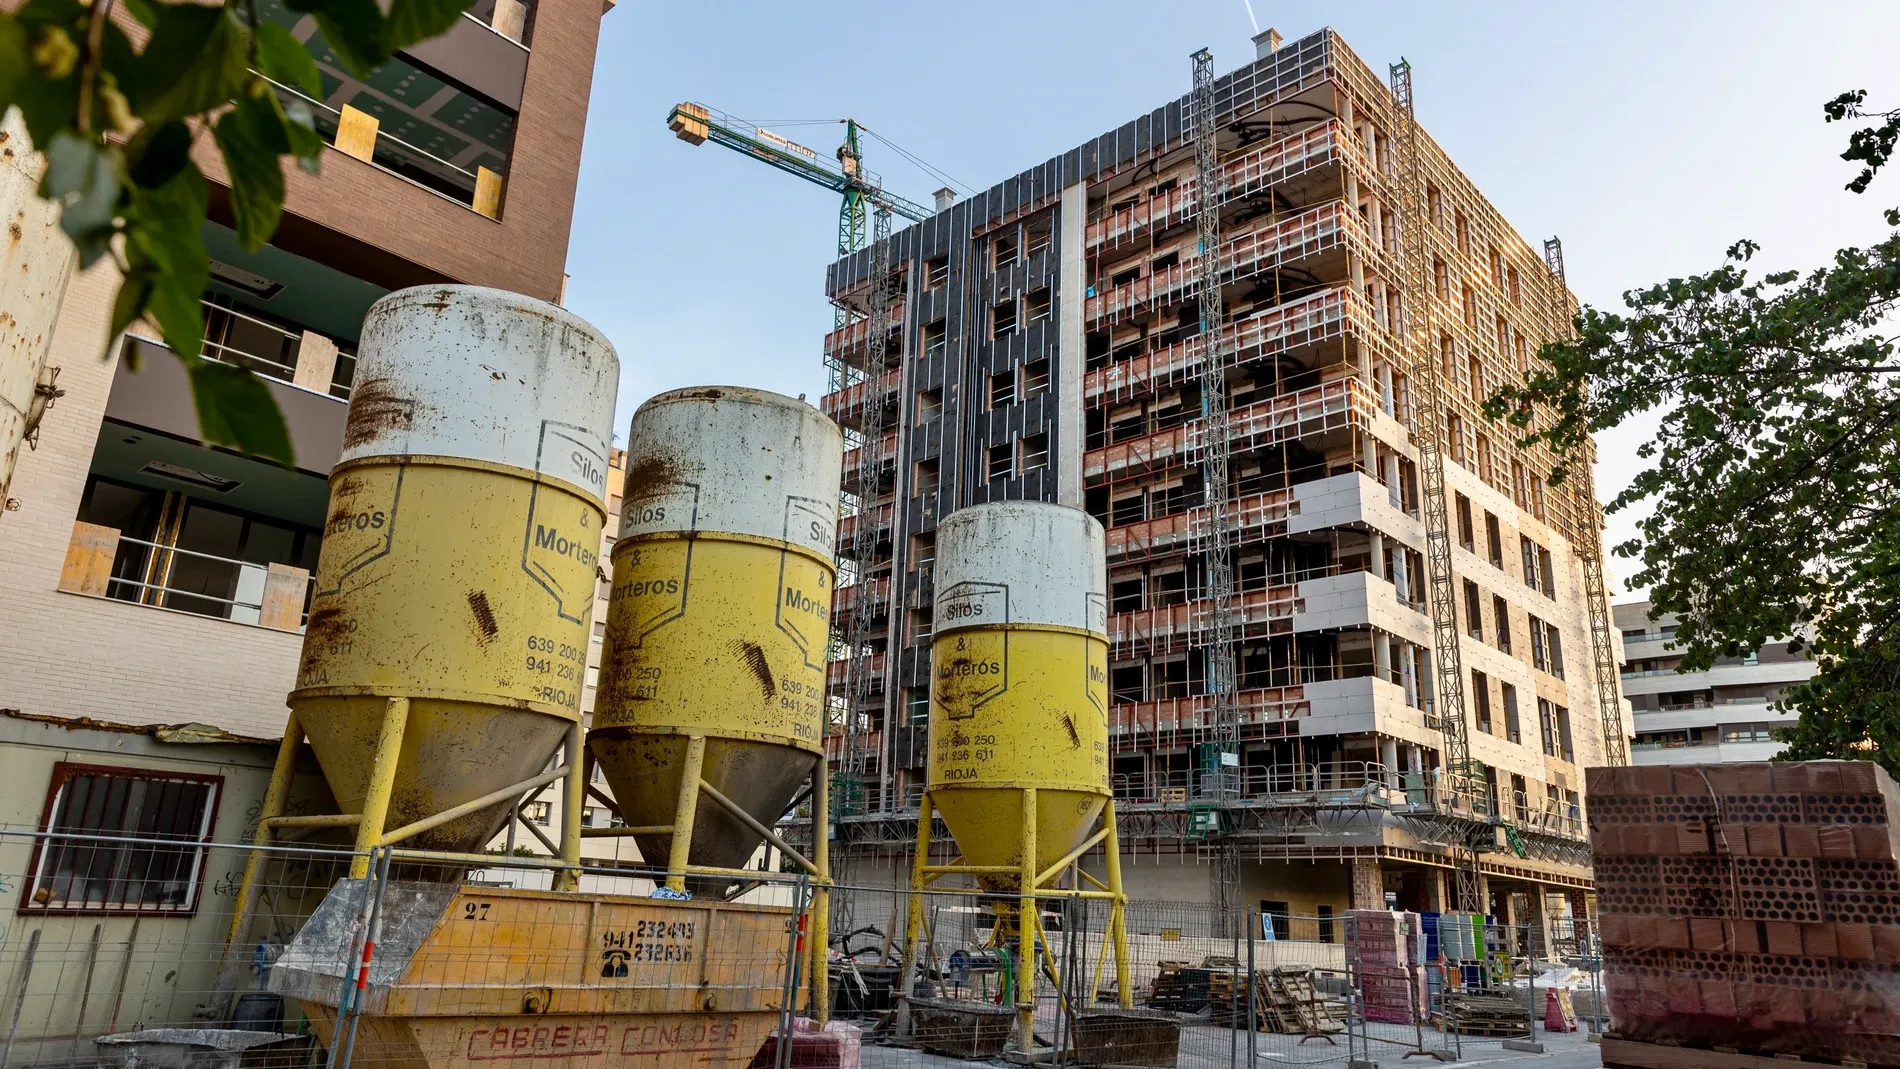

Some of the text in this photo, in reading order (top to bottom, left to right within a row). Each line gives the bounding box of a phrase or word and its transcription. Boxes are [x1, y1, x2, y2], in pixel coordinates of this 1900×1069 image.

[571, 451, 604, 491] Silos
[580, 508, 588, 528] &
[626, 507, 665, 529] Silos
[632, 549, 641, 568] &
[819, 570, 825, 588] &
[946, 602, 983, 620] Silos
[527, 635, 555, 654] 639
[559, 643, 577, 661] 200
[957, 637, 965, 652] &
[525, 656, 551, 674] 941
[557, 663, 575, 682] 236
[637, 667, 661, 680] 250
[636, 684, 658, 699] 611
[782, 679, 802, 695] 639
[541, 686, 576, 710] RIOJA
[781, 696, 800, 712] 941
[936, 738, 949, 749] 639
[974, 734, 996, 746] 250
[936, 749, 994, 763] 941 236 611
[944, 767, 978, 780] RIOJA
[464, 902, 492, 921] 27
[603, 931, 634, 949] 941
